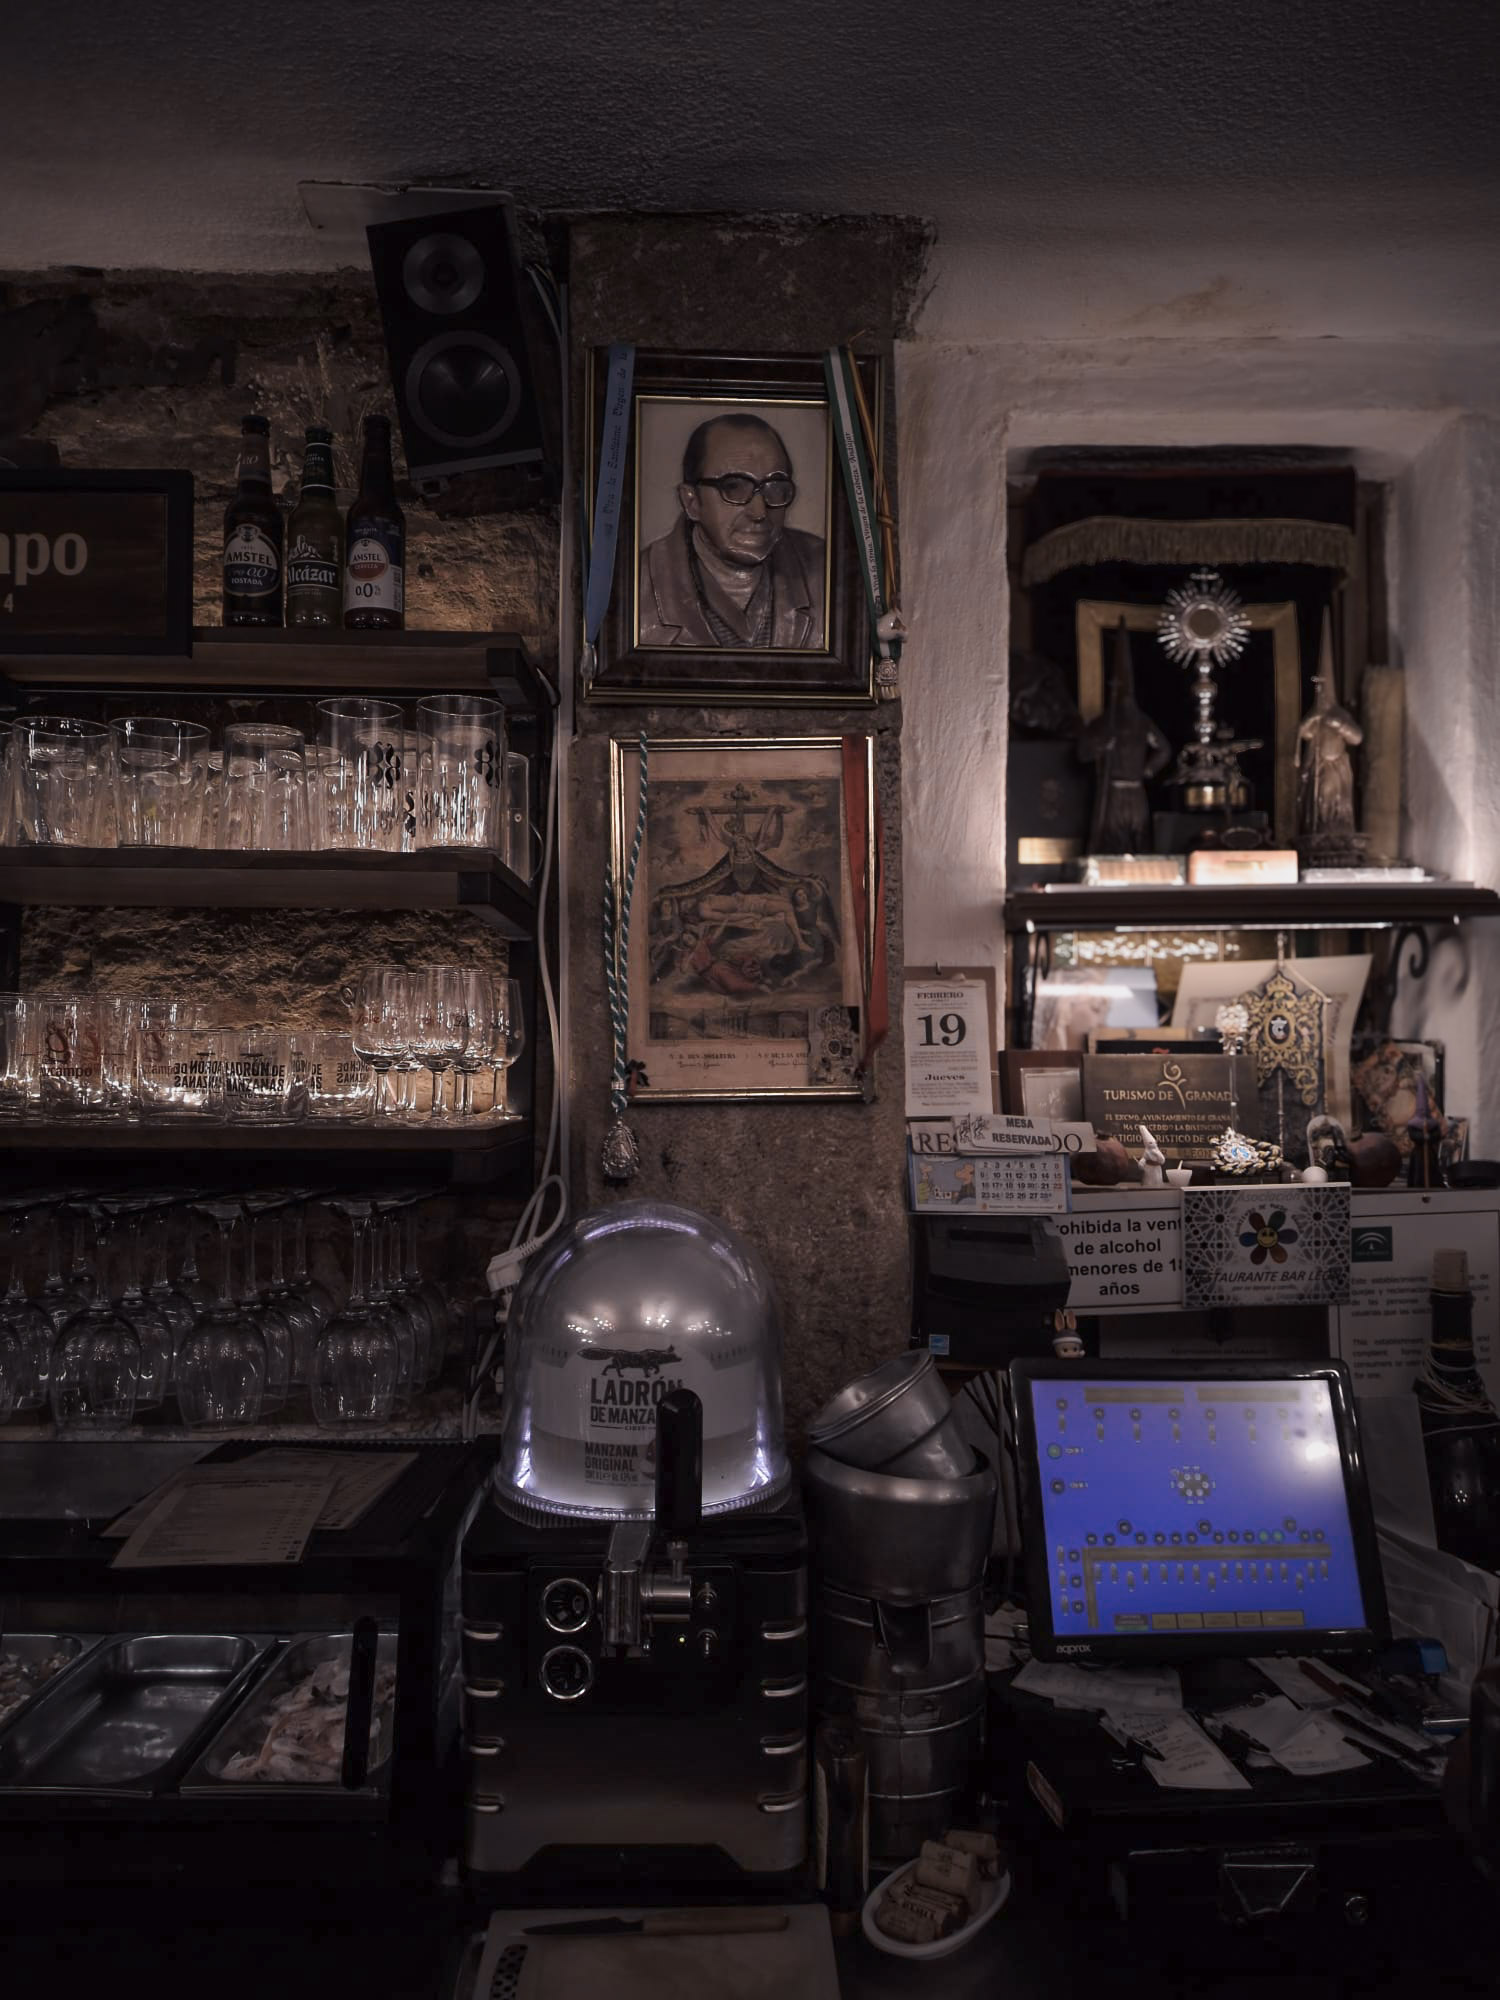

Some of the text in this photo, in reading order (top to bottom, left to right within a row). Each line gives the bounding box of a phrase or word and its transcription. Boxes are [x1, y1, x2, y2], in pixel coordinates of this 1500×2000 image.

[226, 551, 273, 566] AMSTEL
[353, 553, 382, 562] AMSTEL
[917, 991, 964, 999] FEBRERO
[917, 1013, 966, 1046] 19
[272, 1065, 285, 1077] DE
[924, 1073, 965, 1081] Jueves
[1103, 1089, 1155, 1101] TURISMO
[1158, 1090, 1174, 1101] DE
[1006, 1117, 1034, 1129] MESA
[992, 1132, 1052, 1146] RESERVADA
[1192, 1134, 1204, 1143] DE
[1127, 1218, 1141, 1232] la
[1074, 1238, 1161, 1255] de alcohol
[1143, 1259, 1163, 1273] de
[1191, 1271, 1278, 1283] RESTAURANTE
[1280, 1271, 1306, 1281] BAR
[1099, 1282, 1140, 1295] años
[590, 1405, 656, 1425] DE MANZA
[585, 1441, 638, 1458] MANZANA
[584, 1456, 635, 1472] ORIGINAL
